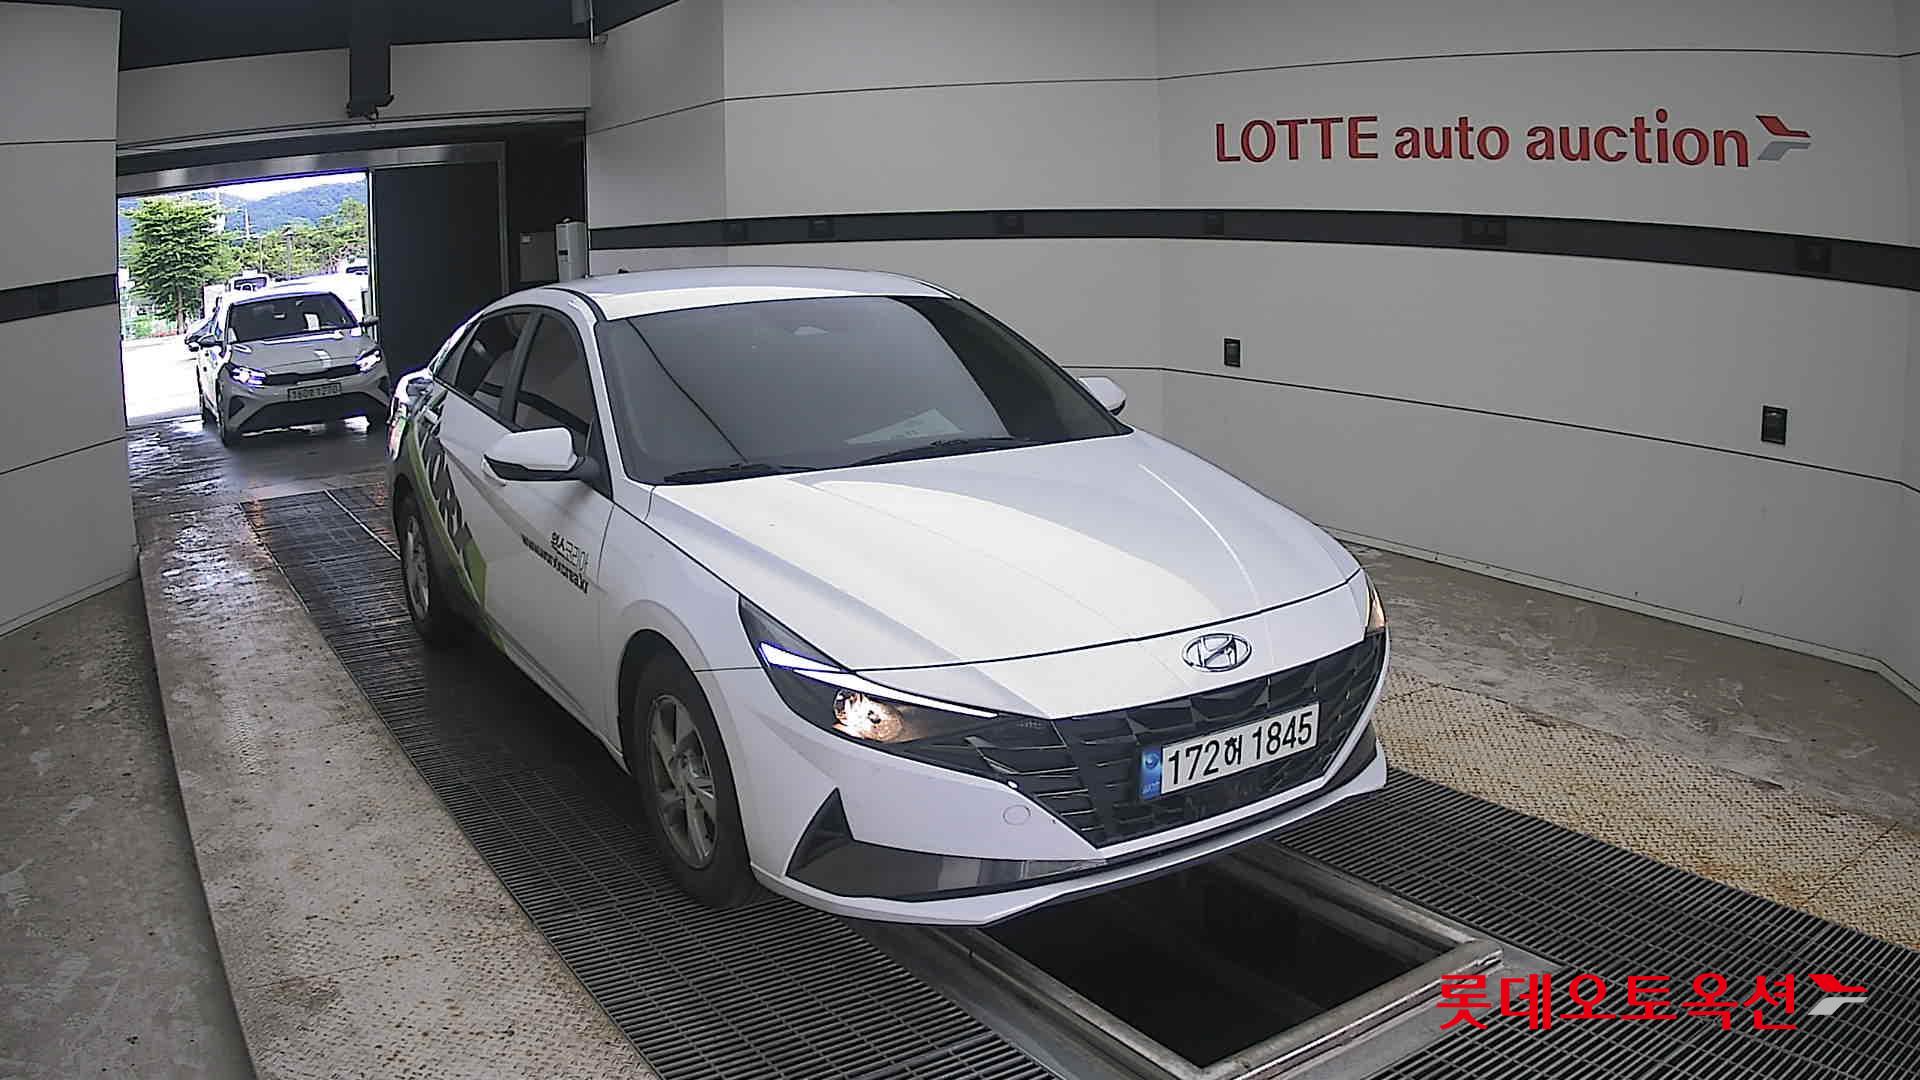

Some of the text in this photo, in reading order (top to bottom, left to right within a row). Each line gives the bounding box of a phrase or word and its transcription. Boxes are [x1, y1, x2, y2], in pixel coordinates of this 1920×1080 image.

[1216, 108, 1750, 168] LOTTE auto auction
[1168, 711, 1313, 785] 172허 1845
